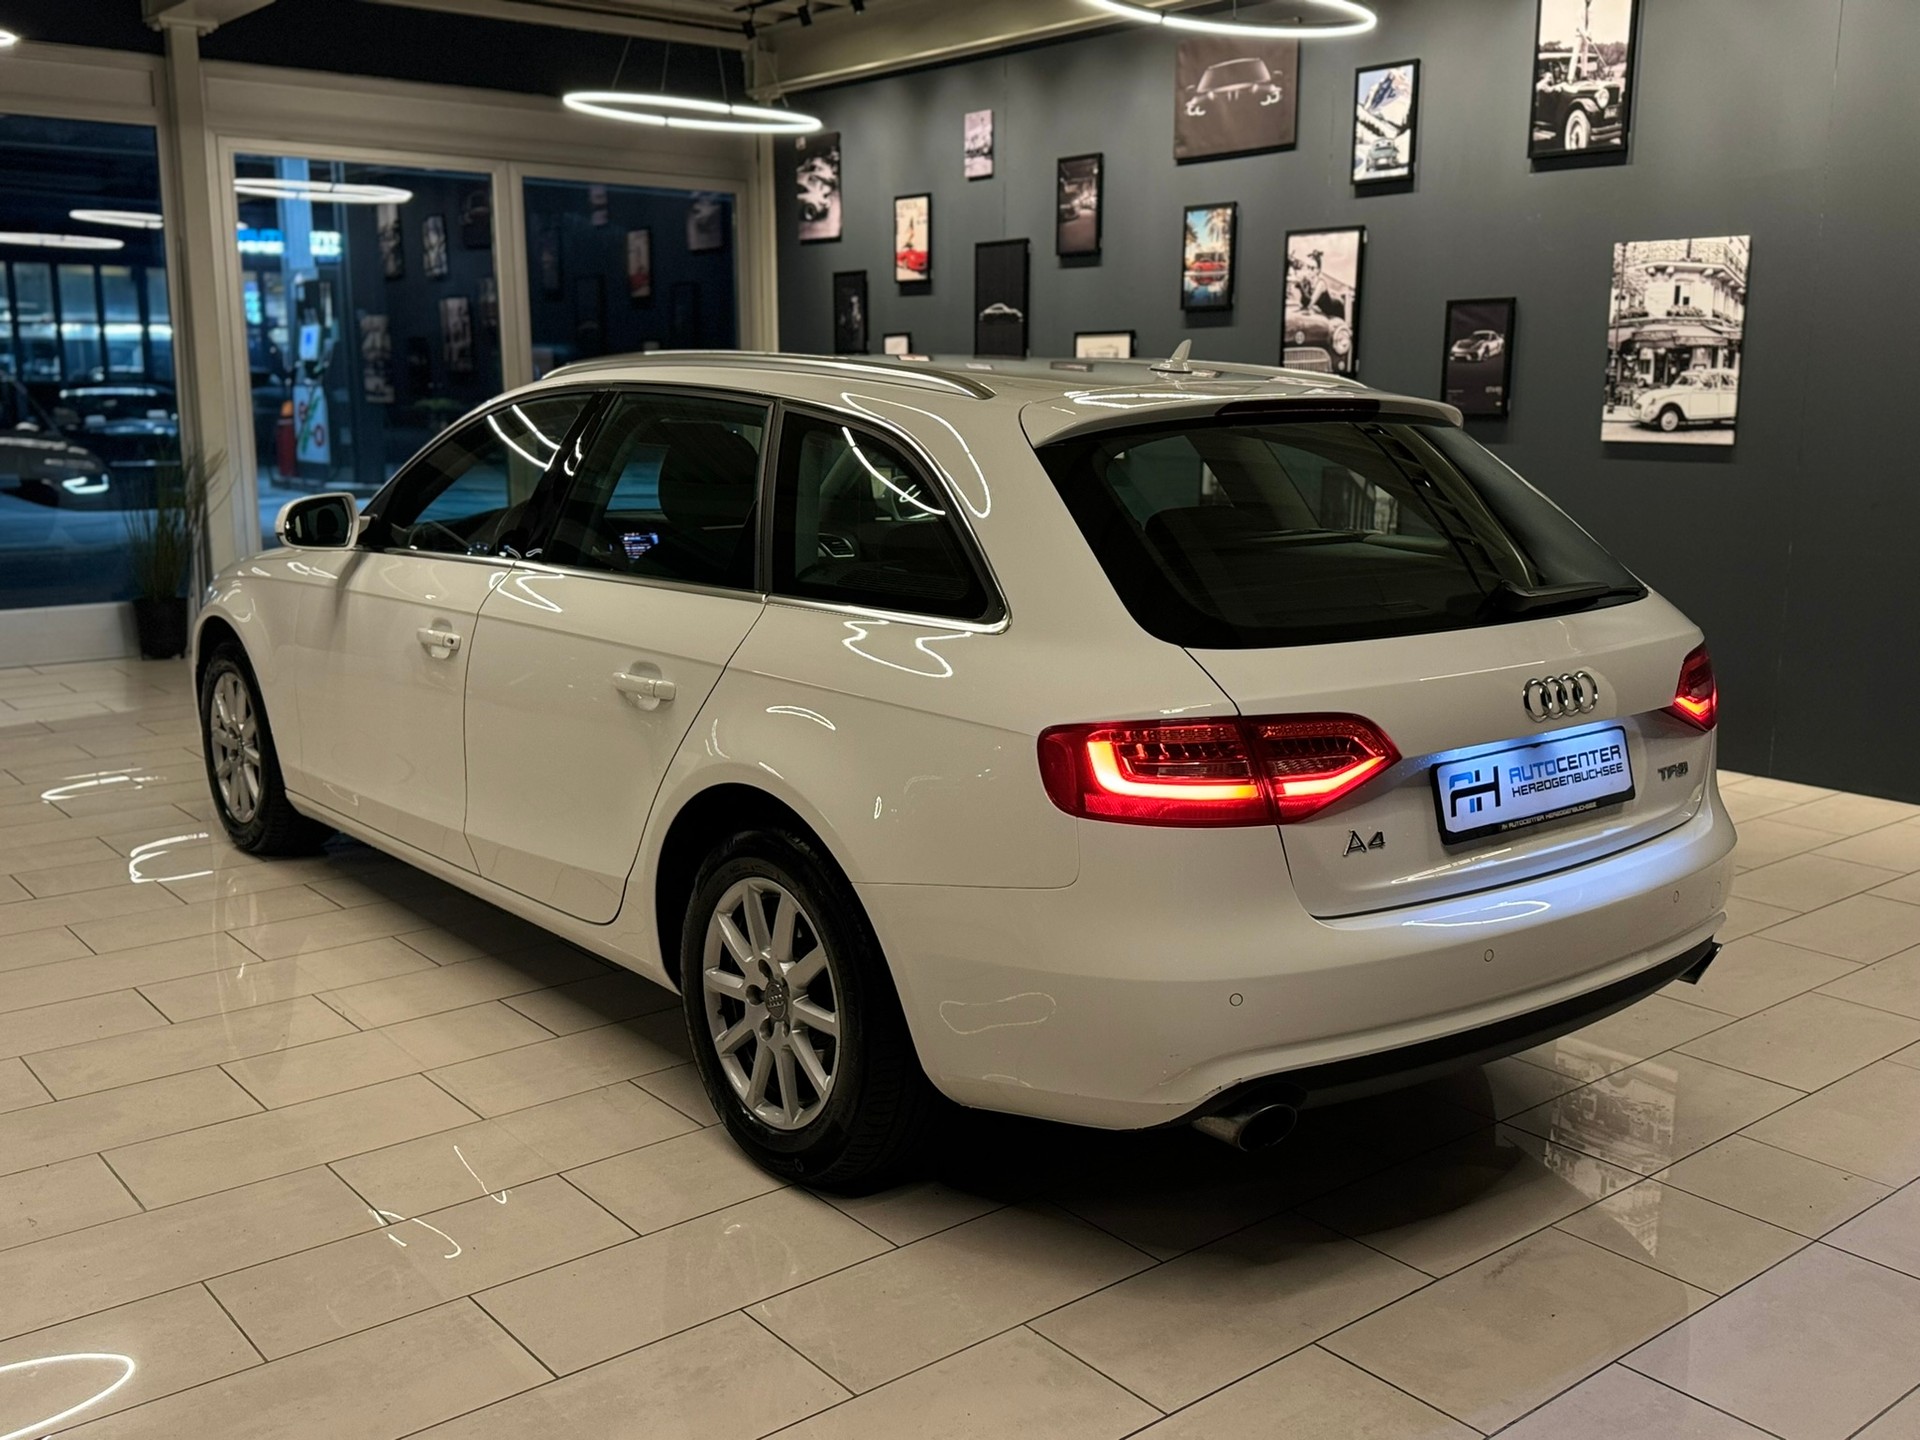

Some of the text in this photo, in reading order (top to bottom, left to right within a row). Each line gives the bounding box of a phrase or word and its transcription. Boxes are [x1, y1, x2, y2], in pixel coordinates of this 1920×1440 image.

[1509, 744, 1622, 784] AUTOCENTER
[1511, 762, 1624, 797] HERZOGENBUCHSEE
[1343, 829, 1386, 857] A4
